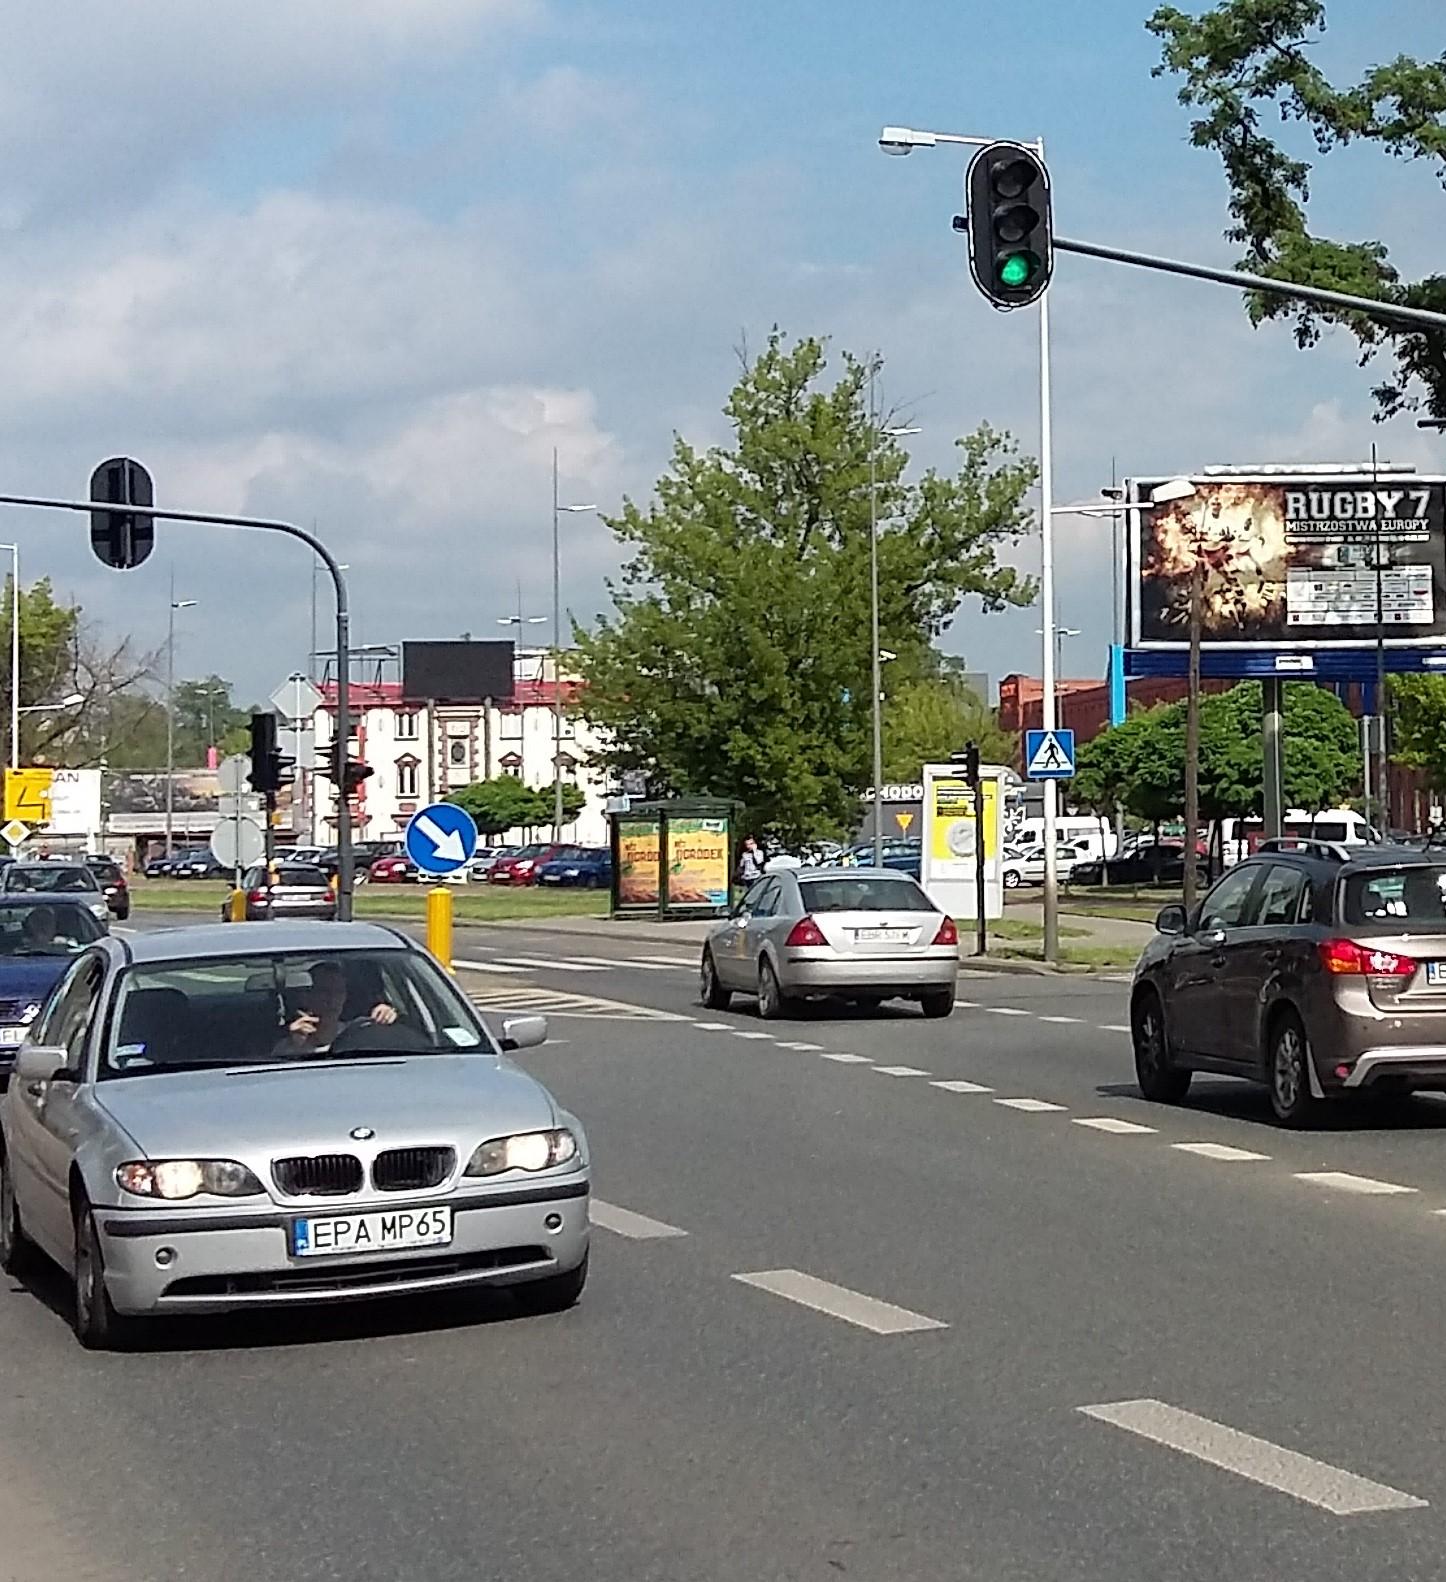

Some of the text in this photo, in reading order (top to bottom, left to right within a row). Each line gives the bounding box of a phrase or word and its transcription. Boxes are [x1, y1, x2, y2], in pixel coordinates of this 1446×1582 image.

[1285, 490, 1431, 519] RUGBY 7
[1285, 518, 1430, 532] MISTRZOSTWA EUROPY
[313, 1210, 446, 1248] EPA MP65
